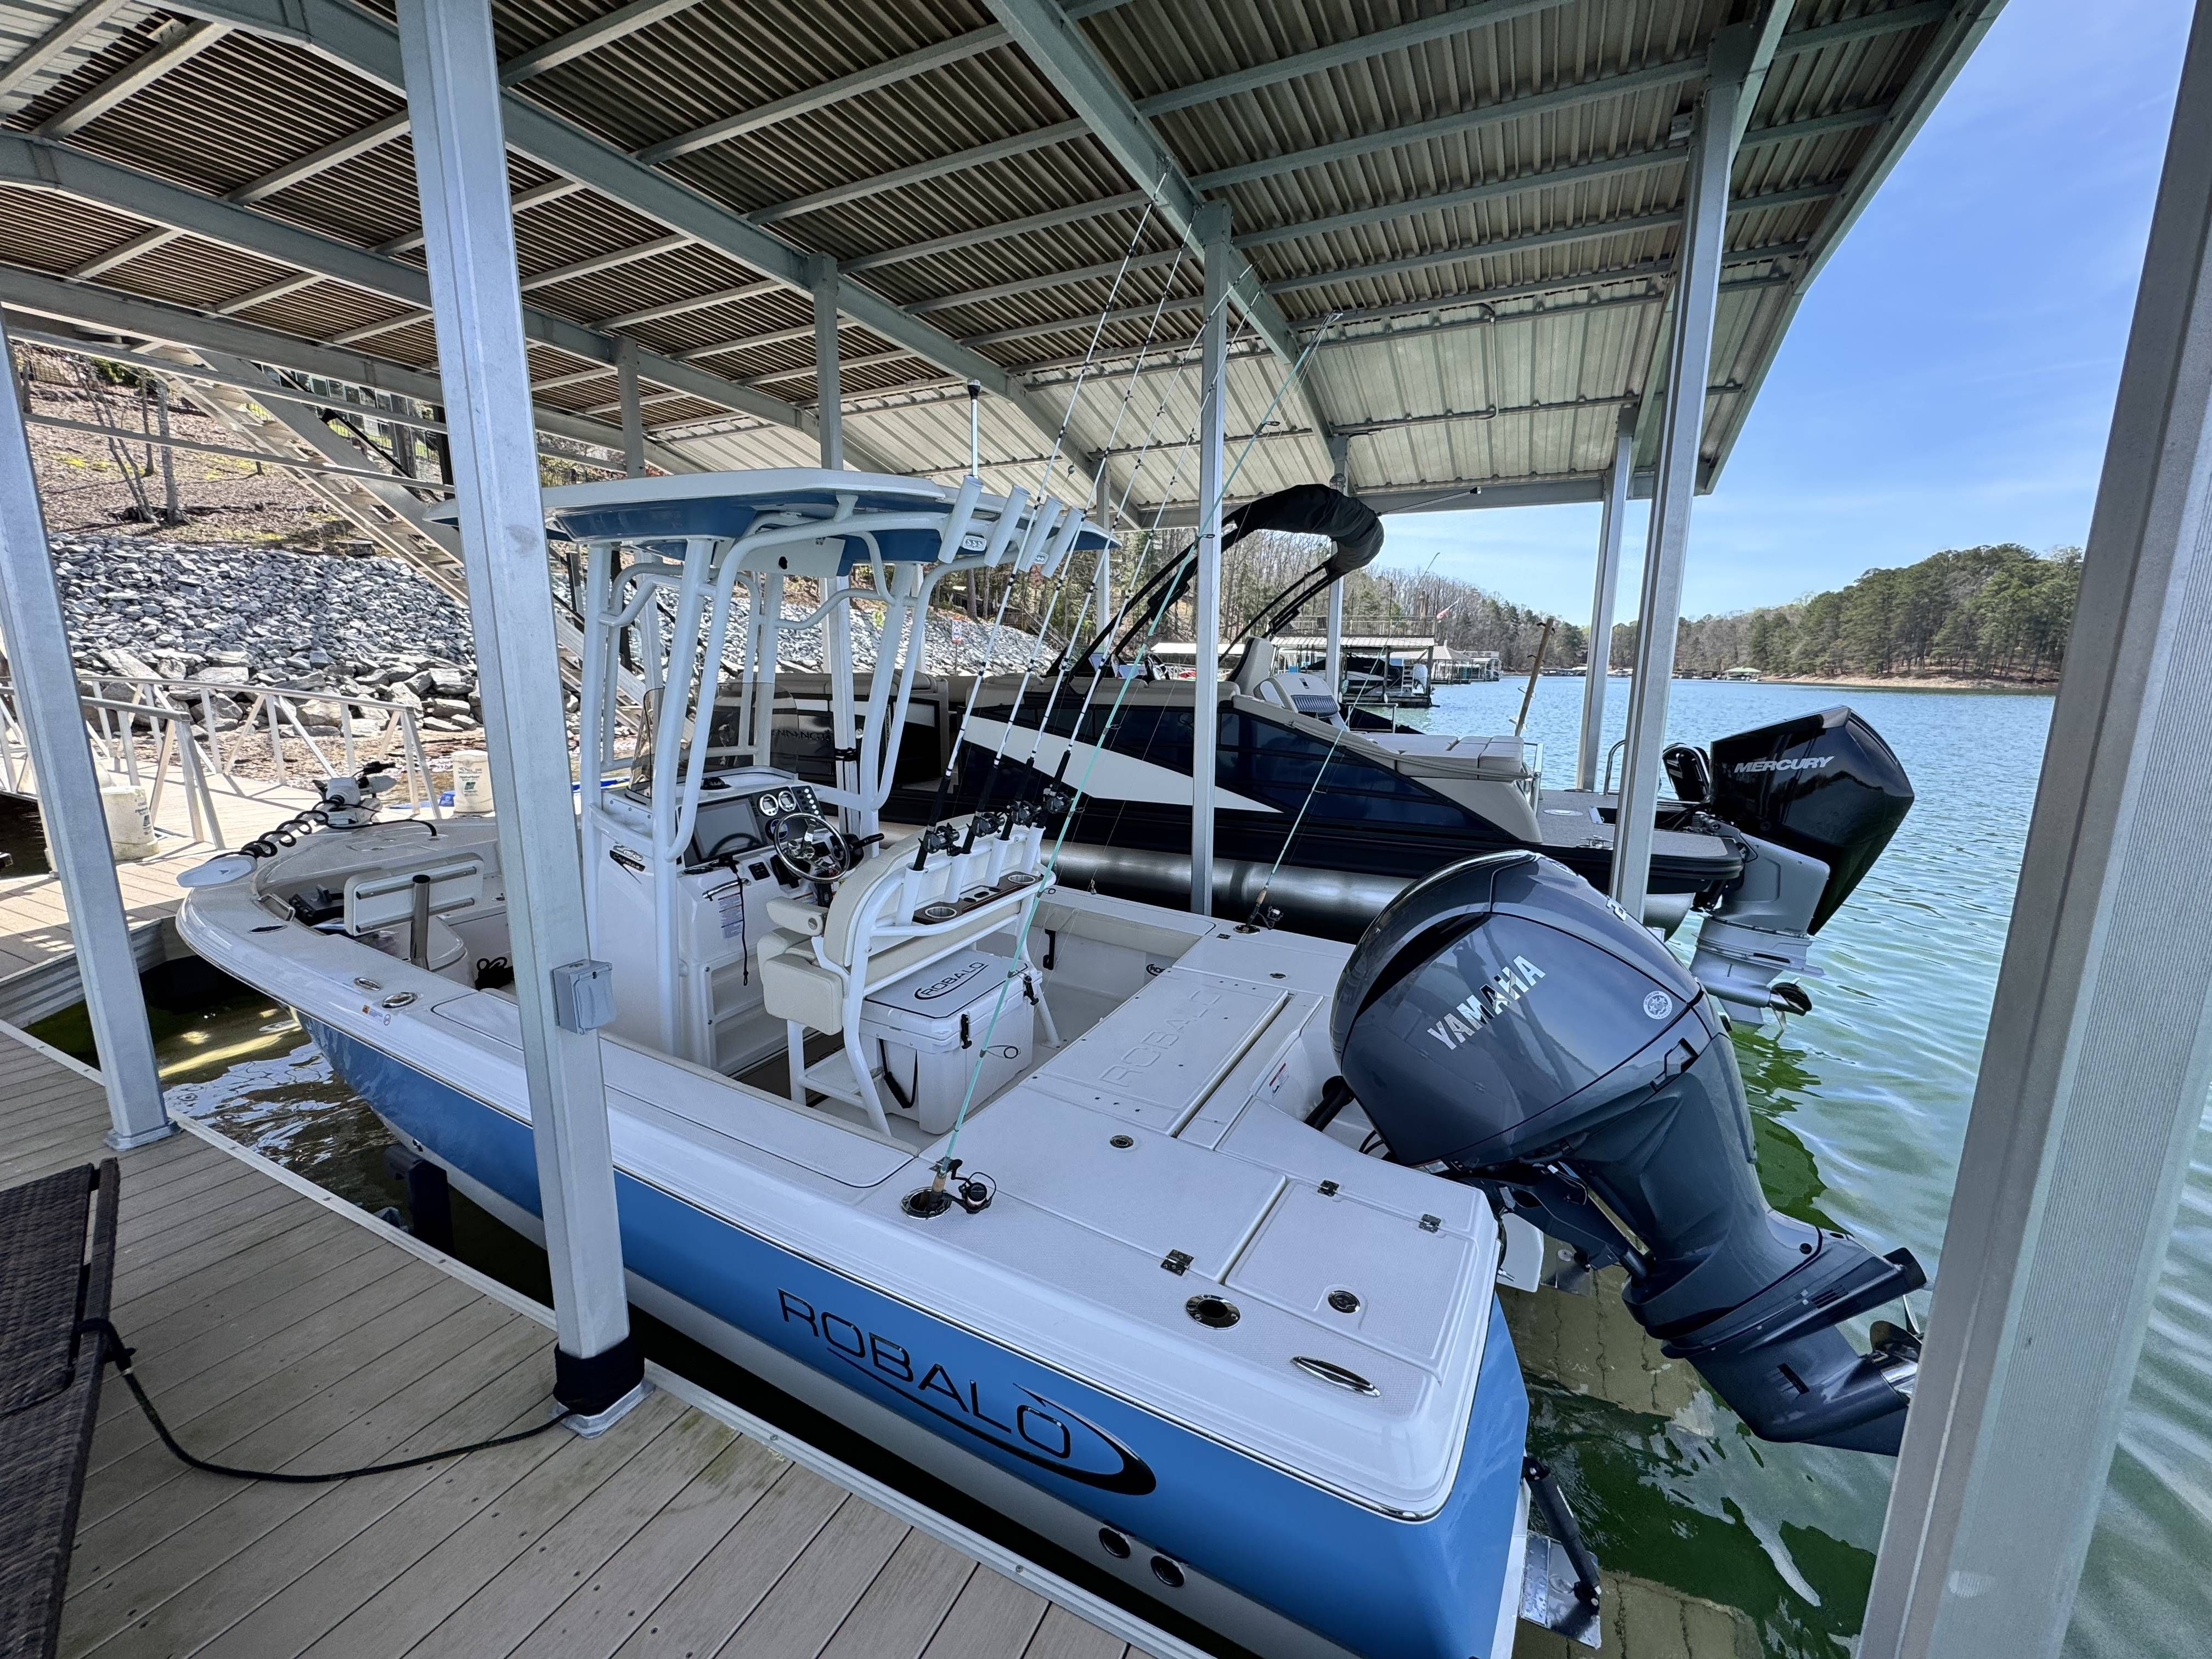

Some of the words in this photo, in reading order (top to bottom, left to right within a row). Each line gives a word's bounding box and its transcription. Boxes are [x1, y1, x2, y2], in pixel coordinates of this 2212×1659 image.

[1734, 756, 1835, 773] MERCURY
[921, 962, 985, 996] ROBALO
[1427, 955, 1546, 1050] YAMAHA
[1099, 991, 1222, 1087] ROBALO
[778, 1288, 1071, 1459] ROBALO
